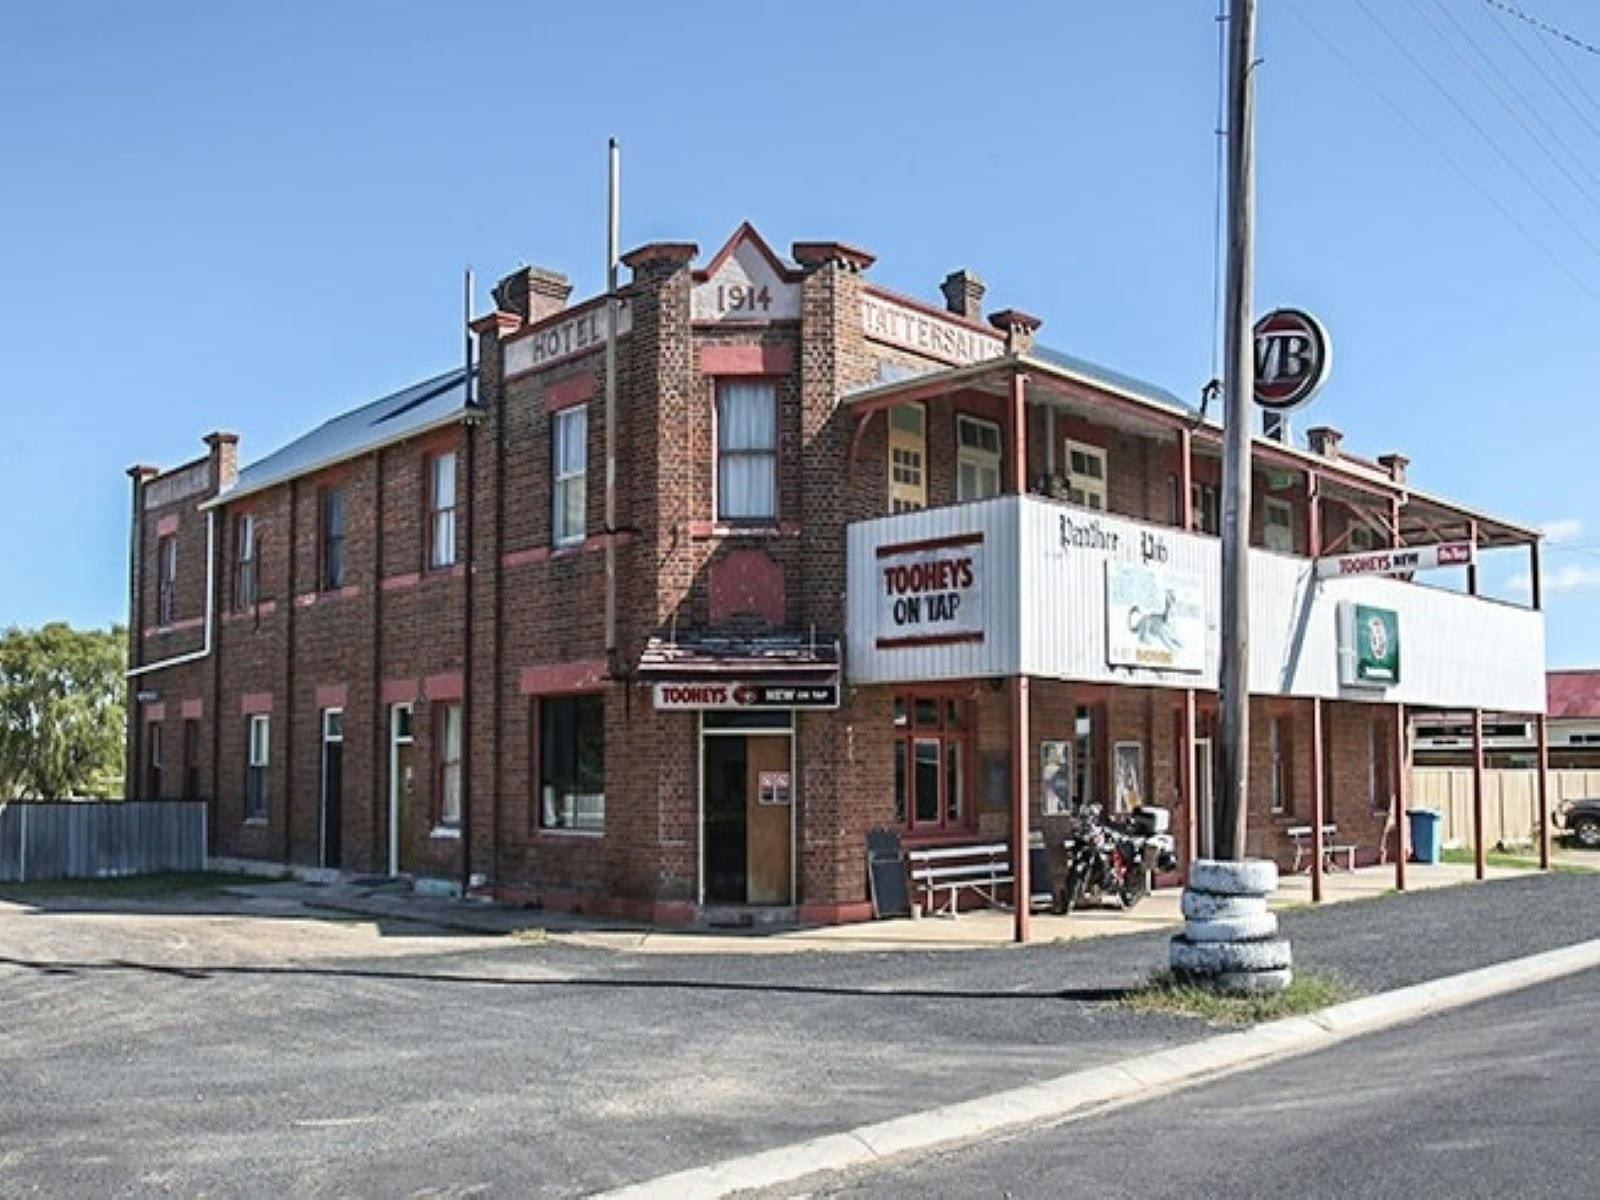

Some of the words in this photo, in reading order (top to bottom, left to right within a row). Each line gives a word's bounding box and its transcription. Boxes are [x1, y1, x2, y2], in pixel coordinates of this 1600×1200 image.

[717, 285, 773, 311] 1914
[533, 313, 600, 361] HOTEL
[1254, 335, 1312, 378] VB
[884, 557, 973, 595] TOOHEYS
[1339, 554, 1391, 573] TOOHEYS
[893, 597, 920, 625] ON
[925, 593, 960, 622] TAP
[662, 688, 727, 703] TOOHEYS
